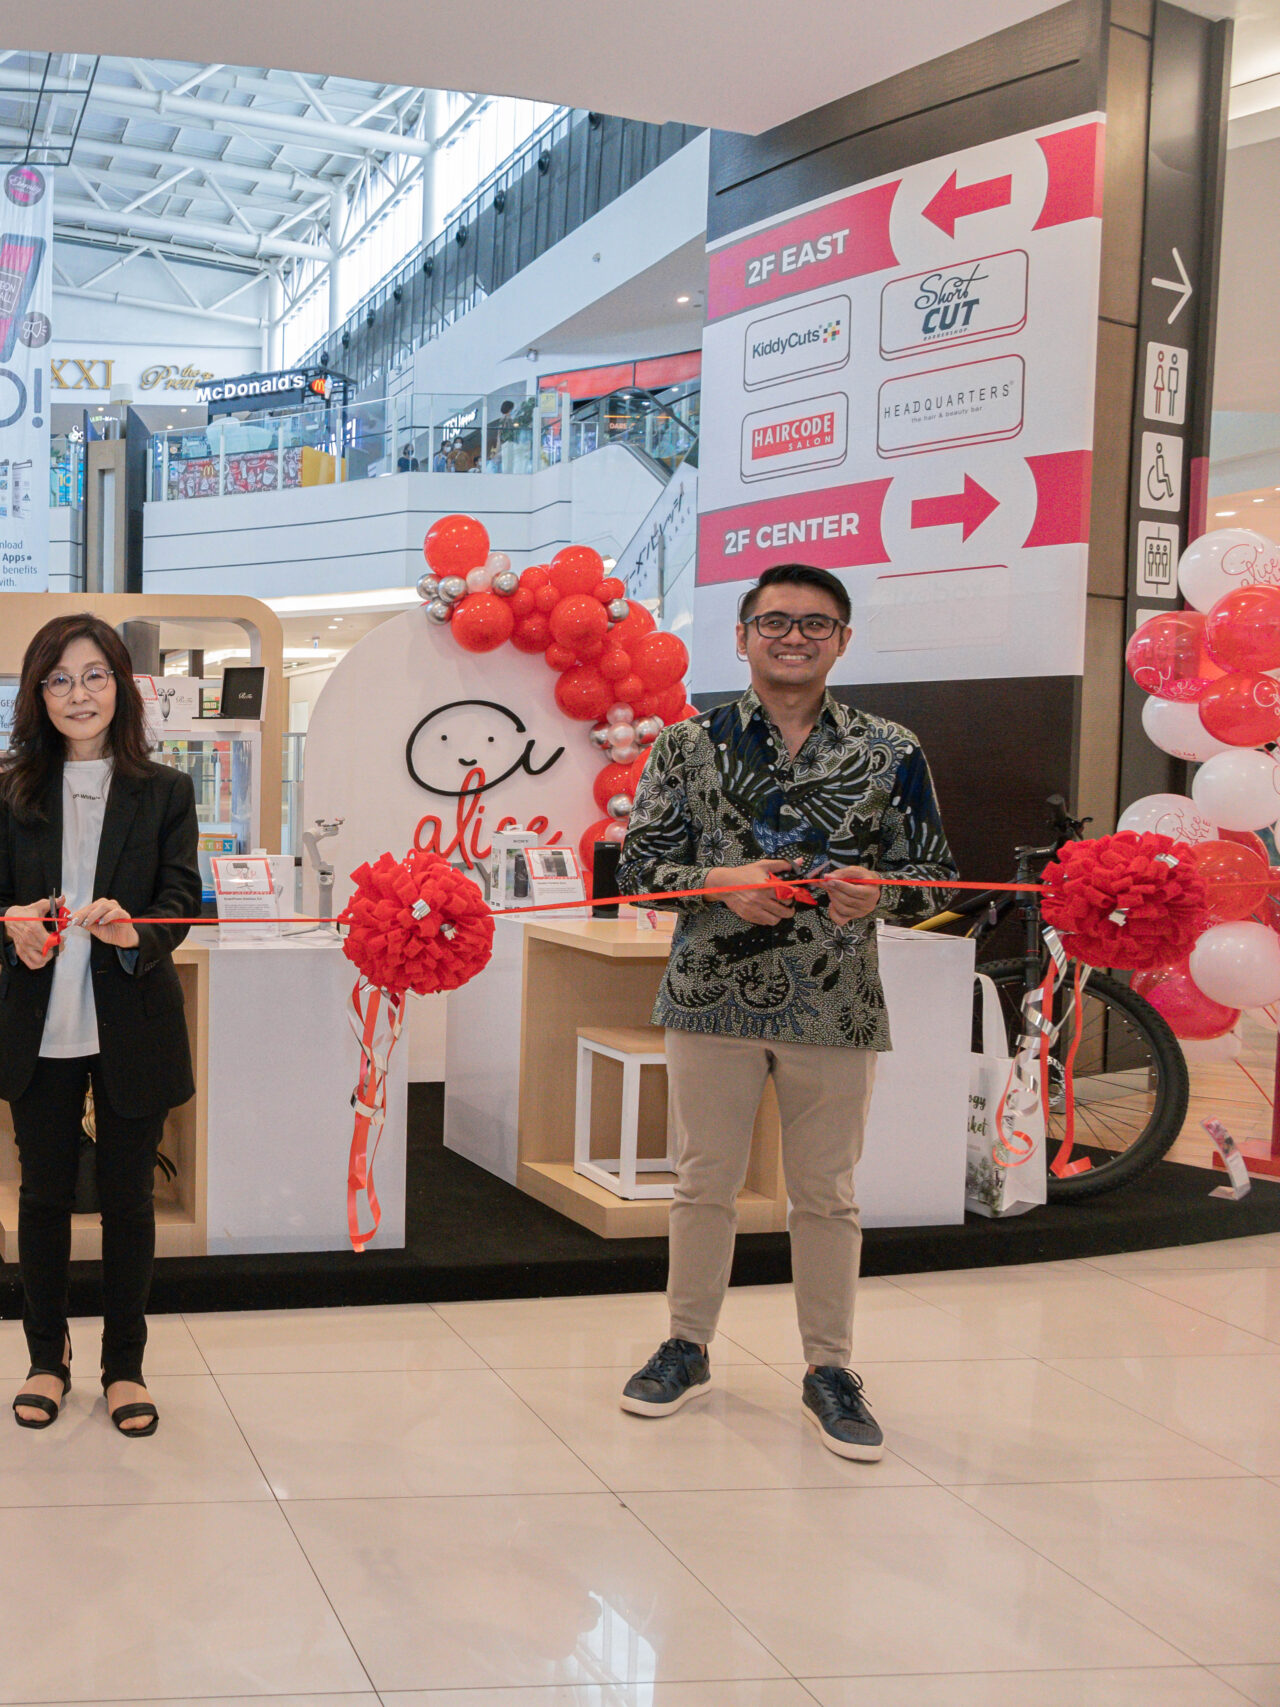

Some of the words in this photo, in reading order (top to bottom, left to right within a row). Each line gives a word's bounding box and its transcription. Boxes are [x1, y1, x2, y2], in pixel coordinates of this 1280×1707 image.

[748, 257, 776, 286] 2F
[781, 229, 851, 274] EAST
[914, 263, 989, 310] Short
[922, 298, 980, 335] CUT
[752, 329, 821, 359] KiddyCuts
[195, 375, 306, 403] McDonald's
[883, 383, 1010, 419] HEADQUARTERS
[754, 414, 832, 448] HAIRCODE
[788, 435, 832, 451] SALON
[723, 527, 751, 556] 2F
[756, 512, 860, 549] CENTER
[2, 552, 25, 563] Apps
[2, 564, 38, 574] benefits
